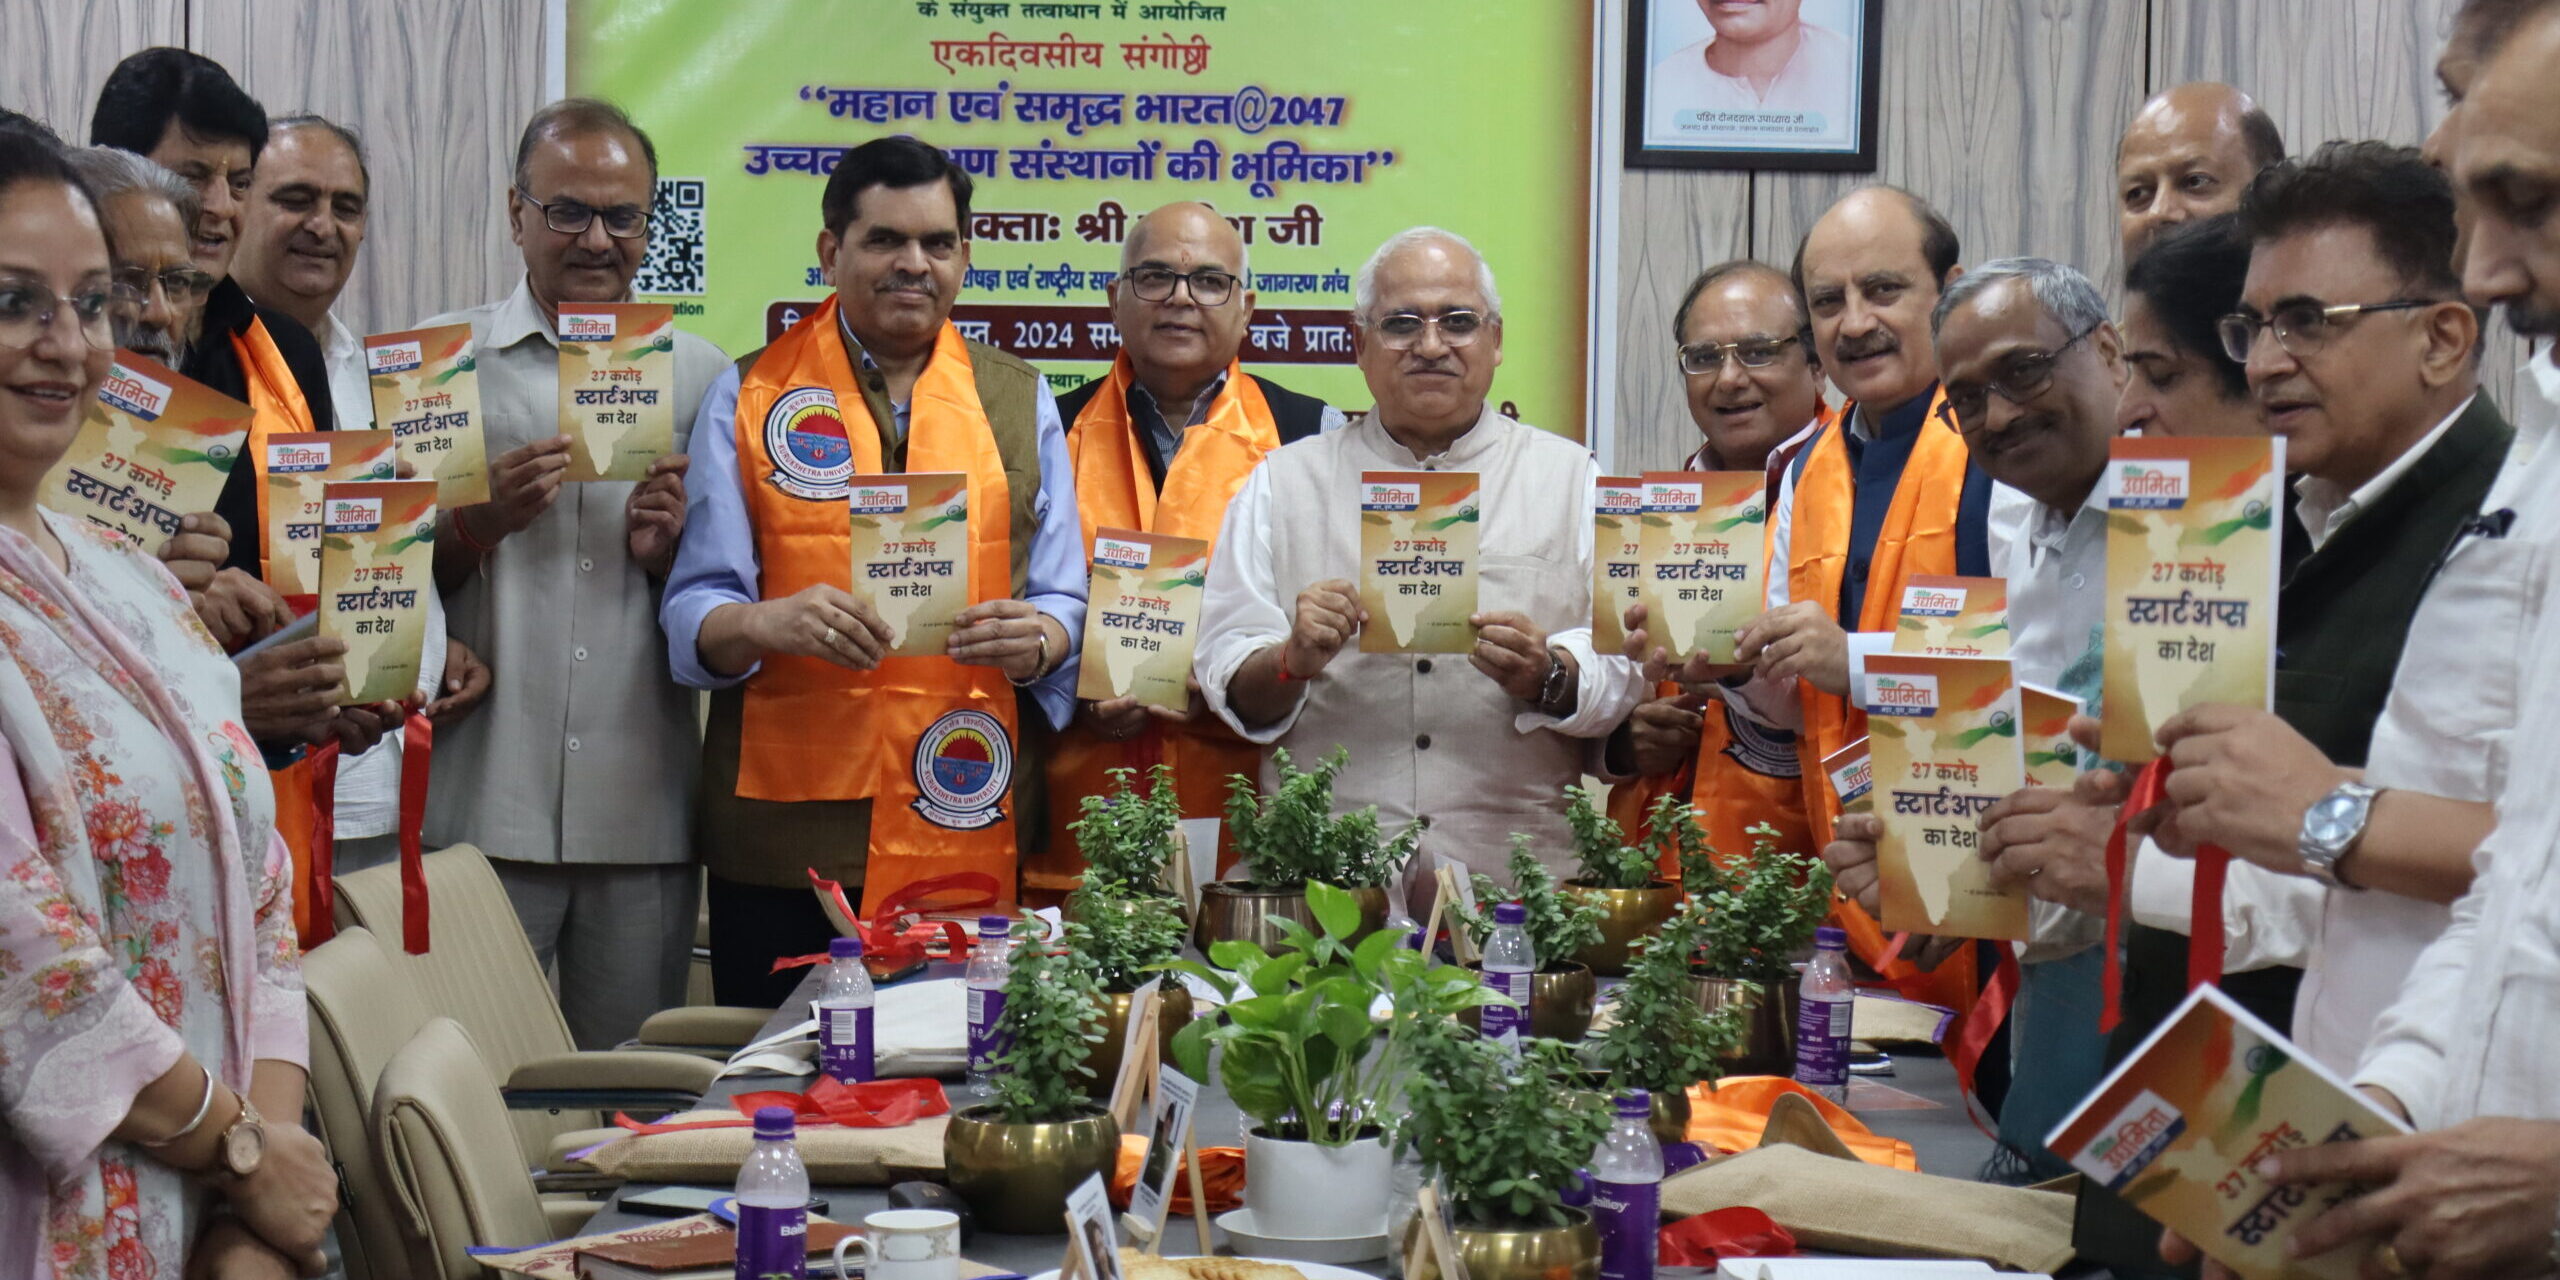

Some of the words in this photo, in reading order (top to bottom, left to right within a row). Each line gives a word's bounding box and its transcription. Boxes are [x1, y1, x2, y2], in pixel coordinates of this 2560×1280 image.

[1112, 1, 1127, 20] में
[1139, 2, 1226, 21] आयोजित
[930, 32, 1104, 75] एकदिवसीय
[1120, 33, 1211, 75] संगोष्ठी
[949, 81, 1010, 122] एवं
[1014, 91, 1125, 136] समृद्ध
[1135, 86, 1345, 134] भारत@2047
[1009, 141, 1157, 182] संस्थानों
[1166, 140, 1221, 182] की
[1075, 201, 1129, 243] श्री
[1265, 204, 1323, 246] जी
[1256, 272, 1318, 294] जागरण
[1322, 268, 1351, 293] मंच
[672, 301, 704, 315] ation
[568, 319, 610, 335] उद्यमिता
[1014, 322, 1074, 349] 2024
[1251, 314, 1291, 351] बजे
[376, 349, 416, 367] उद्यमिता
[609, 367, 641, 385] करोड़
[422, 392, 452, 411] करोड़
[575, 386, 657, 406] स्टार्टअप्स
[392, 411, 469, 438] स्टार्टअप्स
[596, 412, 614, 425] का
[616, 409, 637, 426] देश
[415, 443, 431, 454] का
[434, 437, 453, 452] देश
[278, 448, 325, 465] उद्यमिता
[778, 444, 822, 477] KURUKSHETRA
[823, 461, 855, 477] UNIVERS
[127, 461, 176, 501] करोड़
[2122, 469, 2182, 495] उद्यमिता
[858, 492, 902, 508] उद्यमिता
[1370, 489, 1414, 504] उद्यमिता
[1650, 489, 1695, 506] उद्यमिता
[335, 505, 376, 524] उद्यमिता
[902, 539, 936, 558] करोड़
[1103, 545, 1145, 563] उद्यमिता
[1412, 537, 1447, 556] करोड़
[1694, 539, 1729, 560] करोड़
[371, 562, 403, 585] करोड़
[866, 558, 952, 579] स्टार्टअप्स
[1376, 556, 1464, 576] स्टार्टअप्स
[1656, 560, 1746, 581] स्टार्टअप्स
[2178, 557, 2226, 590] करोड़
[889, 585, 907, 598] का
[910, 581, 932, 598] देश
[1398, 583, 1417, 596] का
[1420, 580, 1441, 596] देश
[1678, 588, 1698, 602] का
[1700, 585, 1723, 602] देश
[336, 586, 416, 612] स्टार्टअप्स
[1137, 595, 1171, 615] करोड़
[1912, 593, 1958, 609] उद्यमिता
[2127, 590, 2249, 627] स्टार्टअप्स
[356, 621, 372, 635] का
[375, 616, 394, 634] देश
[1102, 610, 1185, 637] स्टार्टअप्स
[1121, 636, 1138, 650] का
[1140, 636, 1161, 653] देश
[2157, 641, 2184, 661] का
[2187, 635, 2216, 662] देश
[1877, 682, 1931, 705] उद्यमिता
[1933, 758, 1979, 788] करोड़
[963, 778, 1000, 805] UNIVERSITY
[1923, 828, 1946, 848] का
[1950, 825, 1977, 848] देश
[2102, 1107, 2173, 1172] उद्यमिता
